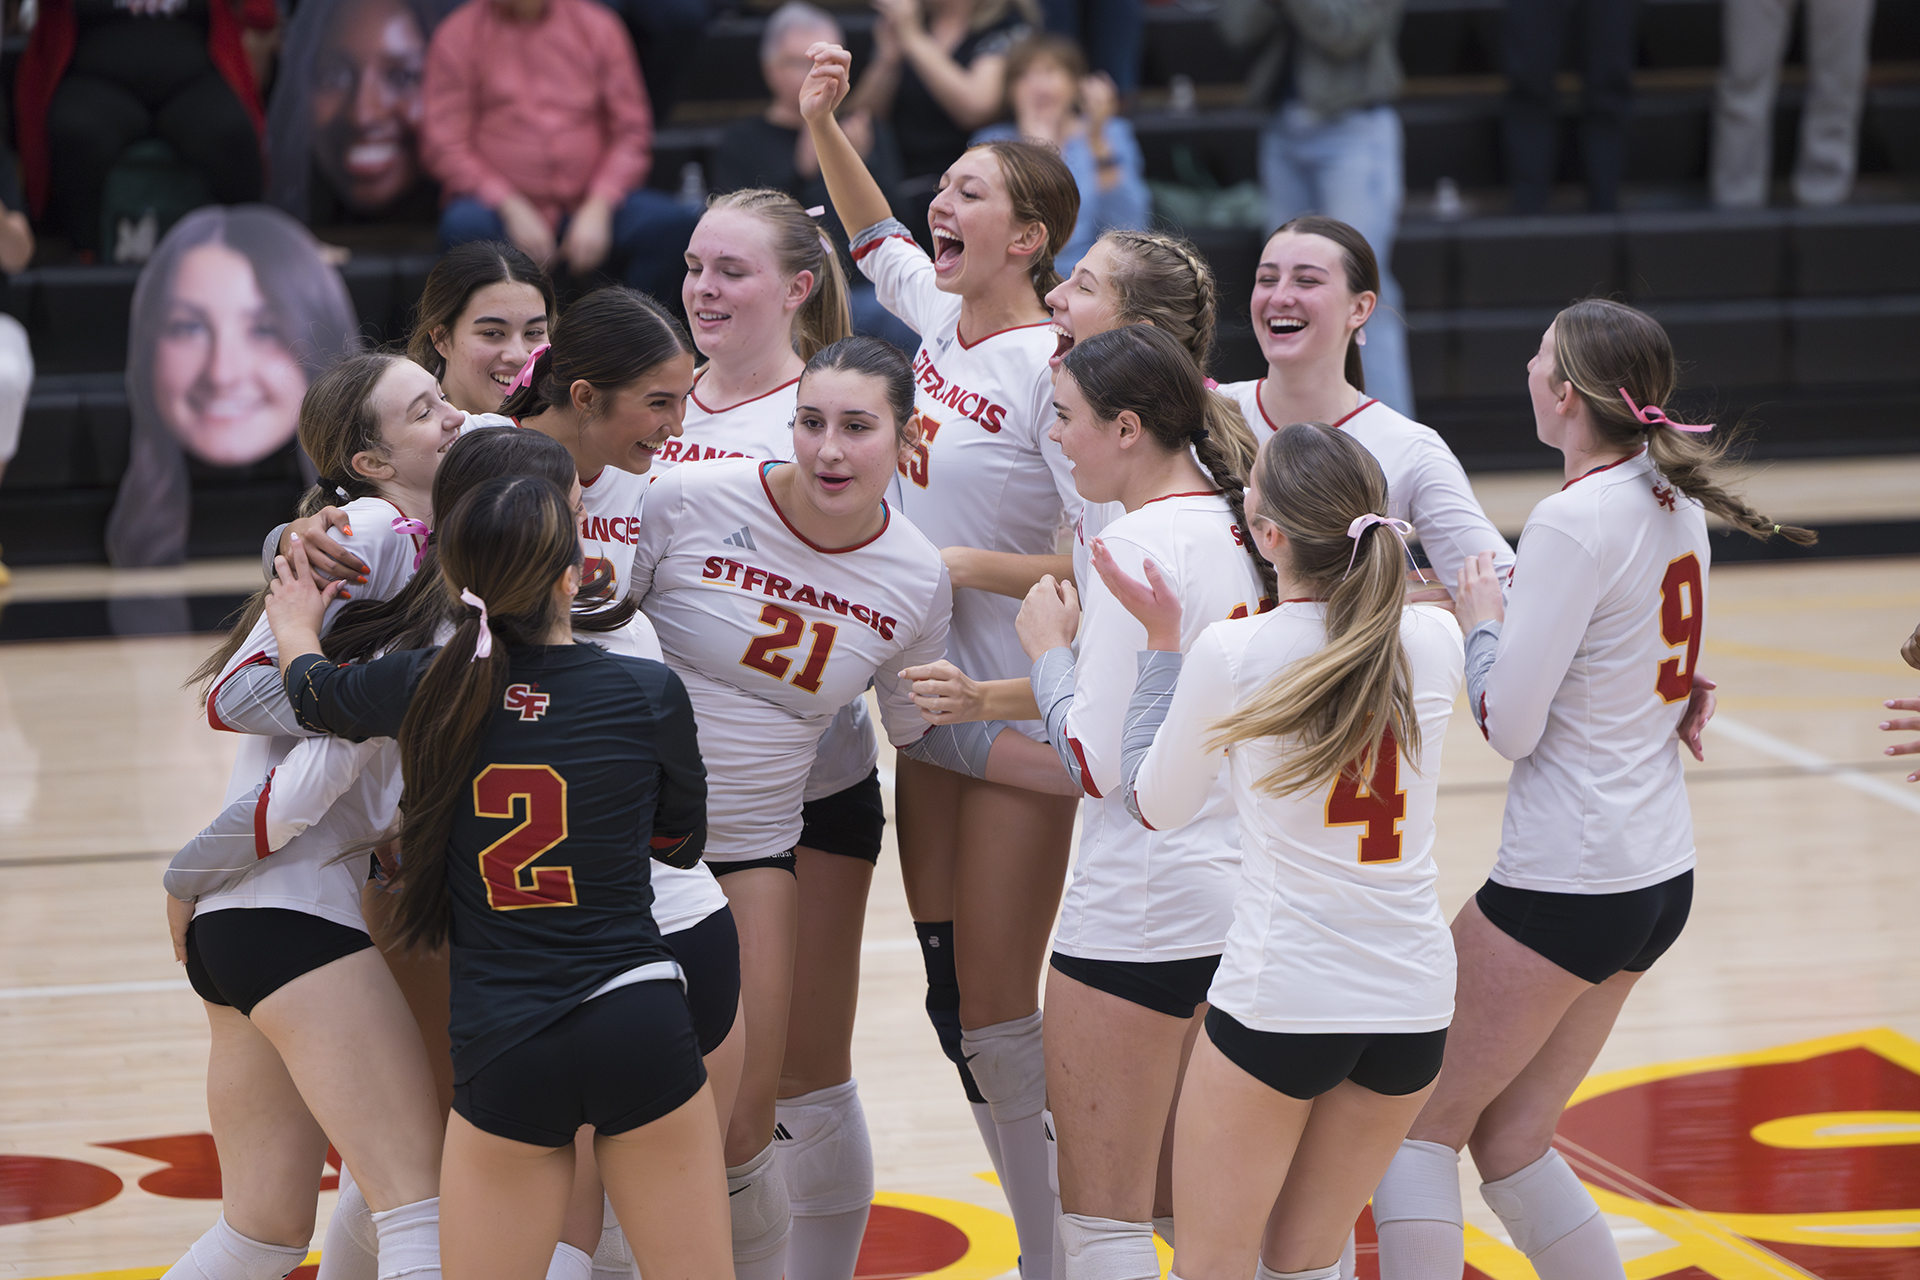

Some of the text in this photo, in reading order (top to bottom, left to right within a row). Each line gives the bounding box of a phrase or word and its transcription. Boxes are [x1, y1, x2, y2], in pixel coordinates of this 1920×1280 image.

[1652, 484, 1676, 515] SF
[739, 603, 839, 695] 21
[1654, 550, 1704, 705] 9
[504, 683, 550, 721] SF
[472, 763, 578, 911] 2
[1324, 710, 1408, 864] 4
